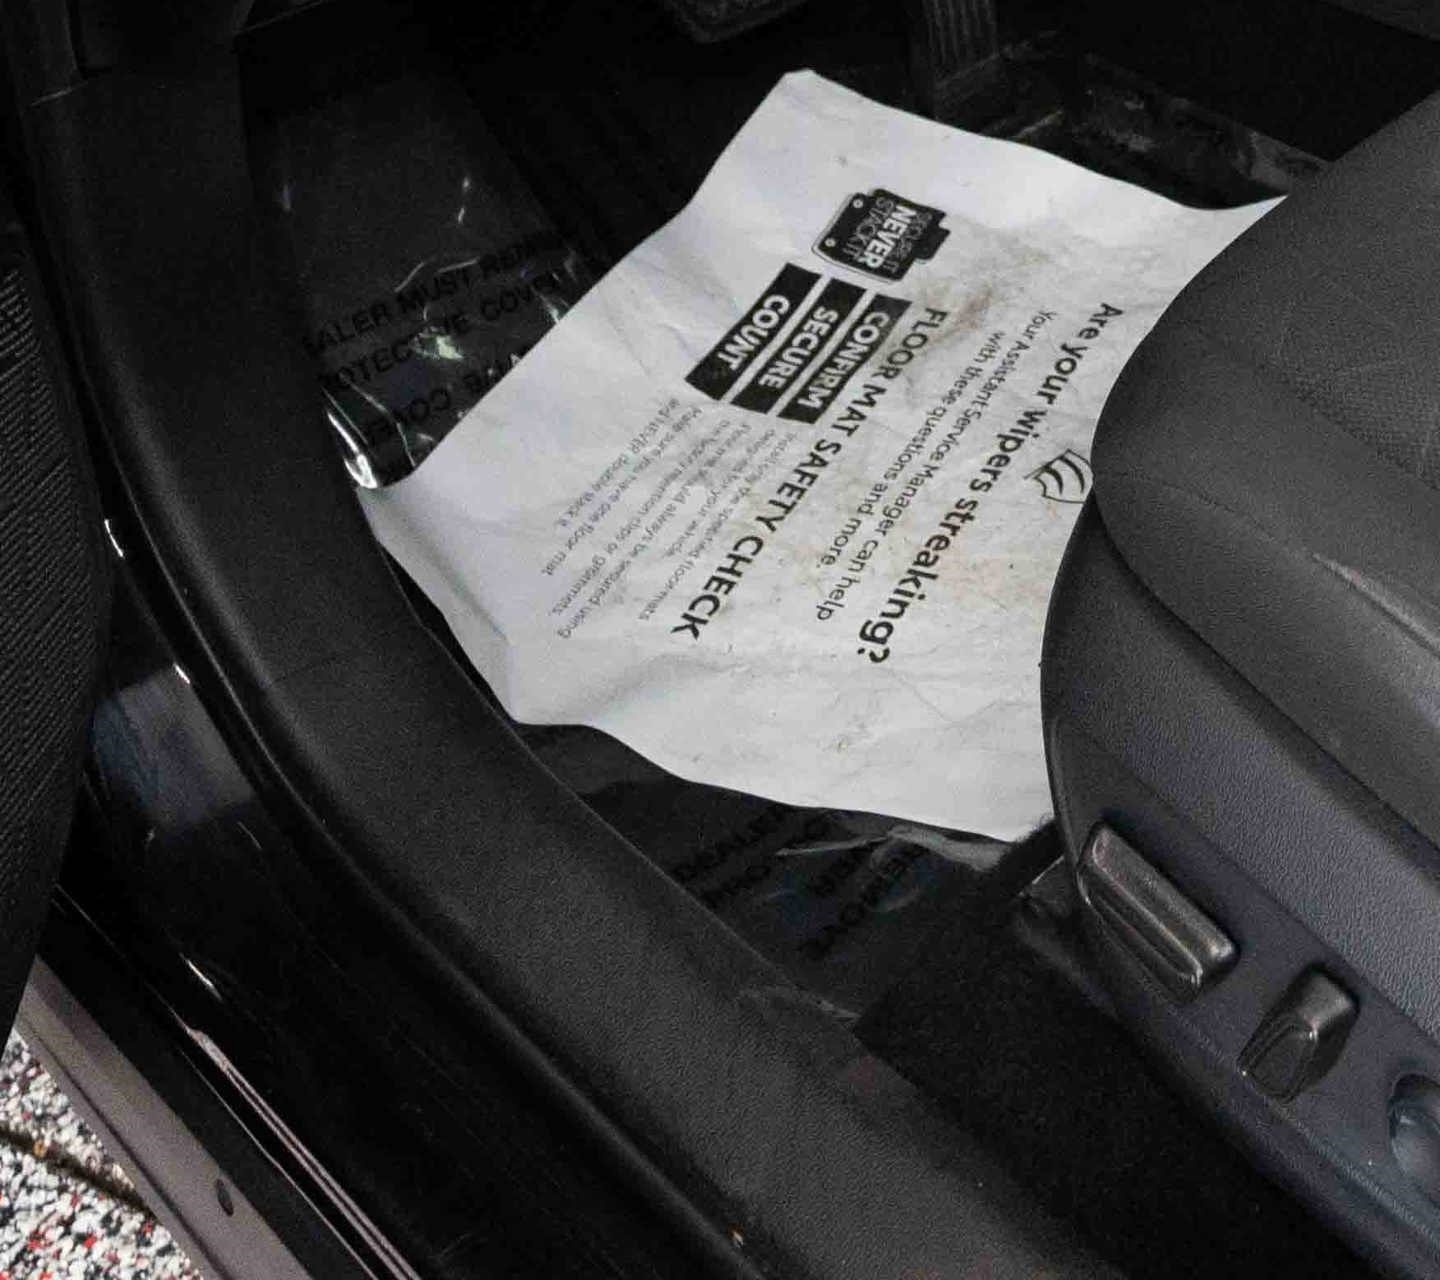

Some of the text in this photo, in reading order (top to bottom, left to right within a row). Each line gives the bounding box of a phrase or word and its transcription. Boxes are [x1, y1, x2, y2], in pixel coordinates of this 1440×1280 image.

[857, 205, 917, 268] NEVER
[717, 295, 790, 371] COUNT
[758, 306, 839, 388] SECURE
[797, 311, 890, 409] CONFIRM
[670, 306, 949, 640] FLOOR MAT SAFETY CHECK
[815, 310, 1057, 621] Your Assistant Service Manager can help
[816, 331, 1006, 569] with these questions and more.
[857, 302, 1124, 664] Are your wipers streaking?
